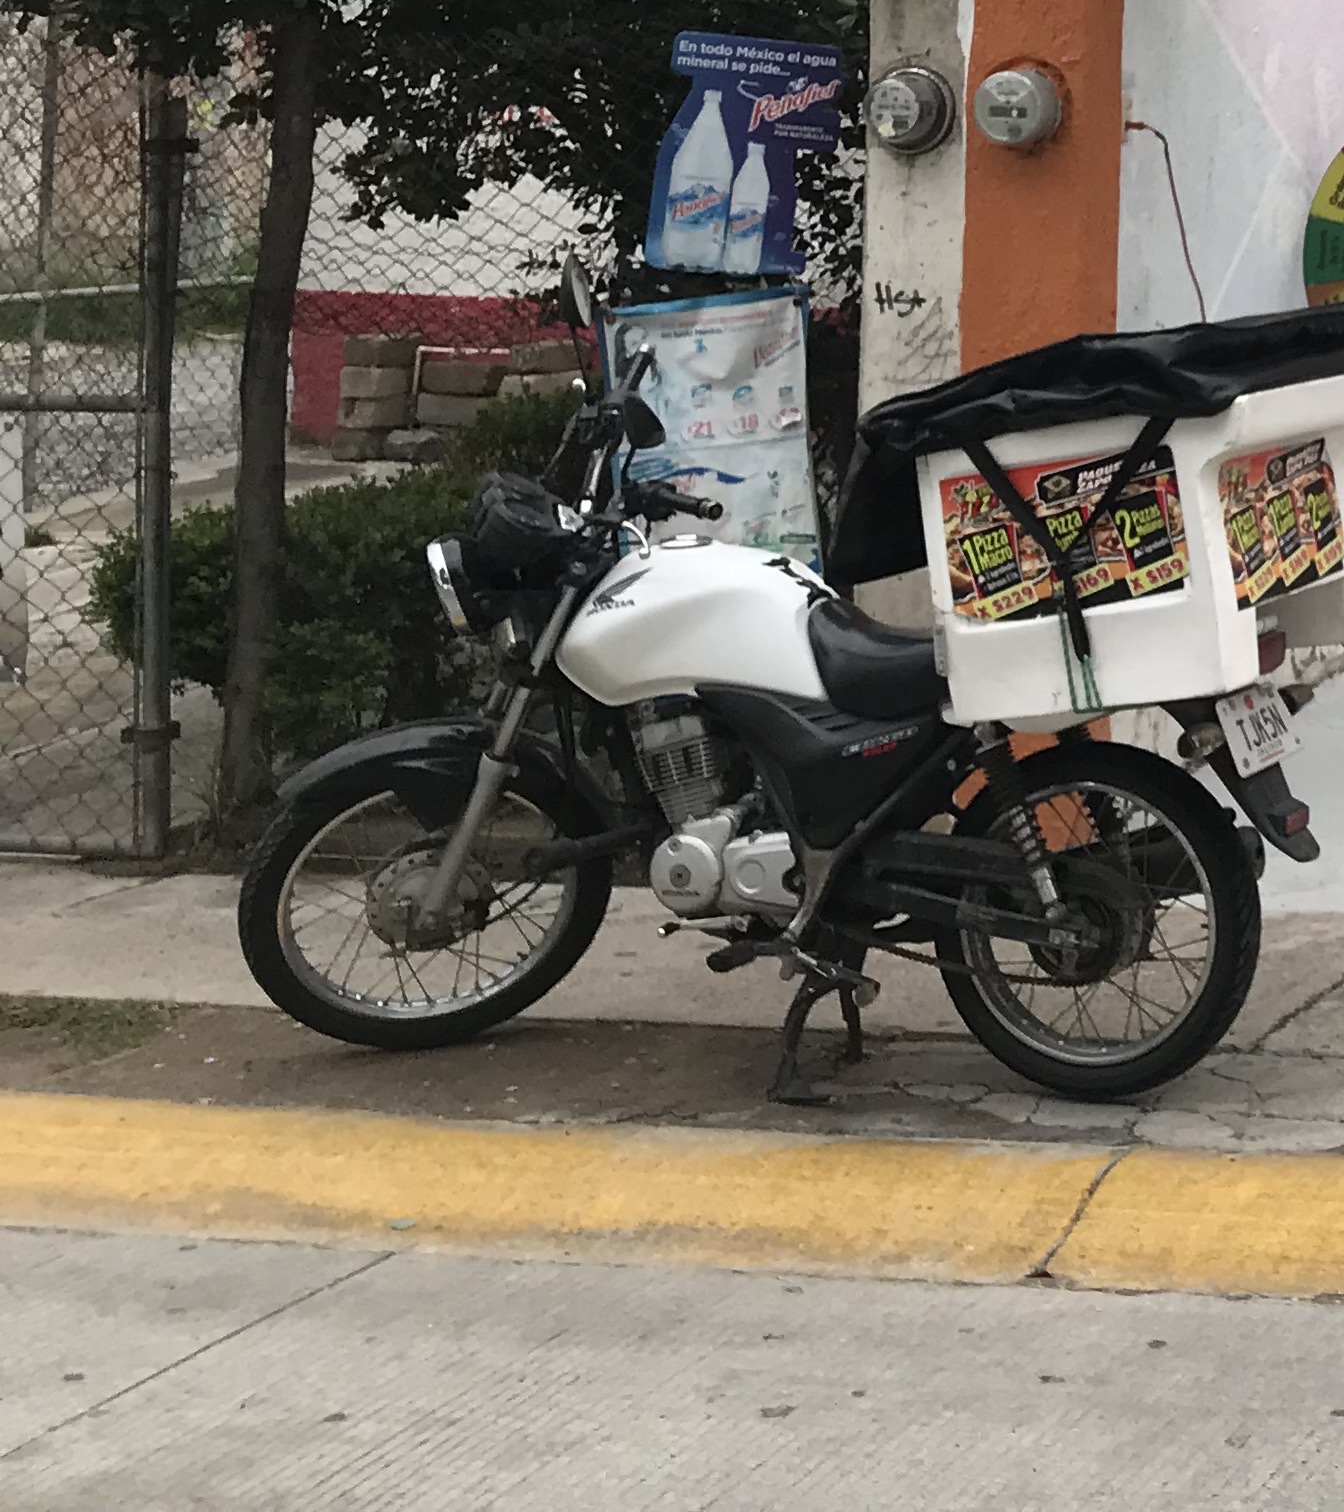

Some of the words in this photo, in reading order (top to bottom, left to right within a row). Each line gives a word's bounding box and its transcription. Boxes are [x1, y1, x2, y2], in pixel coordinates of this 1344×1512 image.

[677, 55, 729, 70] mineral
[731, 62, 747, 72] se
[679, 40, 697, 52] En
[701, 43, 733, 56] todo
[736, 46, 784, 62] México
[788, 51, 800, 62] el
[803, 55, 837, 67] agua
[1046, 510, 1083, 538] Pizza
[1115, 509, 1141, 548] 2
[962, 538, 981, 576] 1
[973, 528, 1009, 558] Pizza
[1145, 558, 1184, 585] $159
[992, 585, 1035, 613] $229
